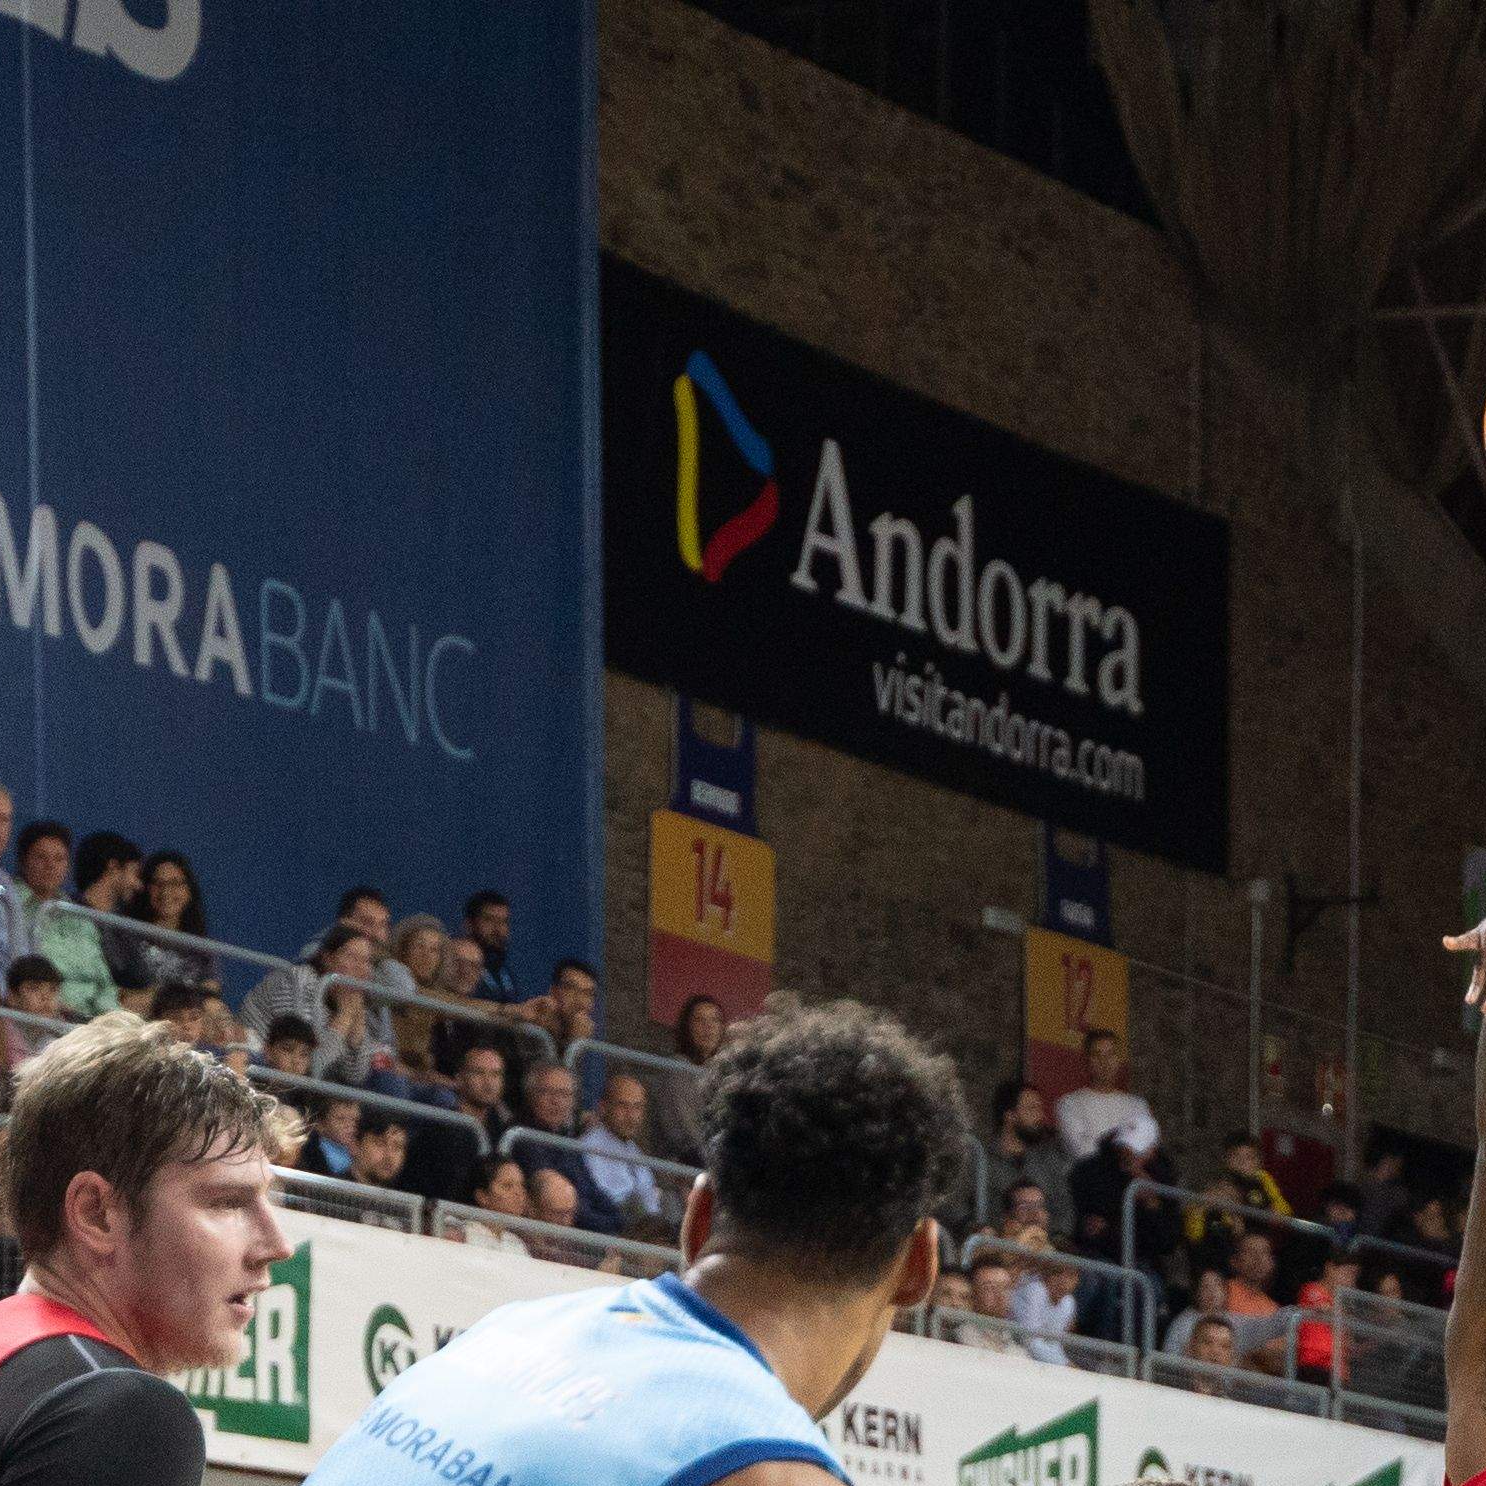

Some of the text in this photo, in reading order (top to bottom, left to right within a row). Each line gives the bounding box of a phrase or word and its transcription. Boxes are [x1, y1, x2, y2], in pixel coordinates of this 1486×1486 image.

[789, 438, 1145, 714] Andorra
[873, 653, 1145, 800] visitandorra.com
[691, 837, 736, 938] 14
[1062, 952, 1096, 1042] 12
[842, 1401, 922, 1455] KERN
